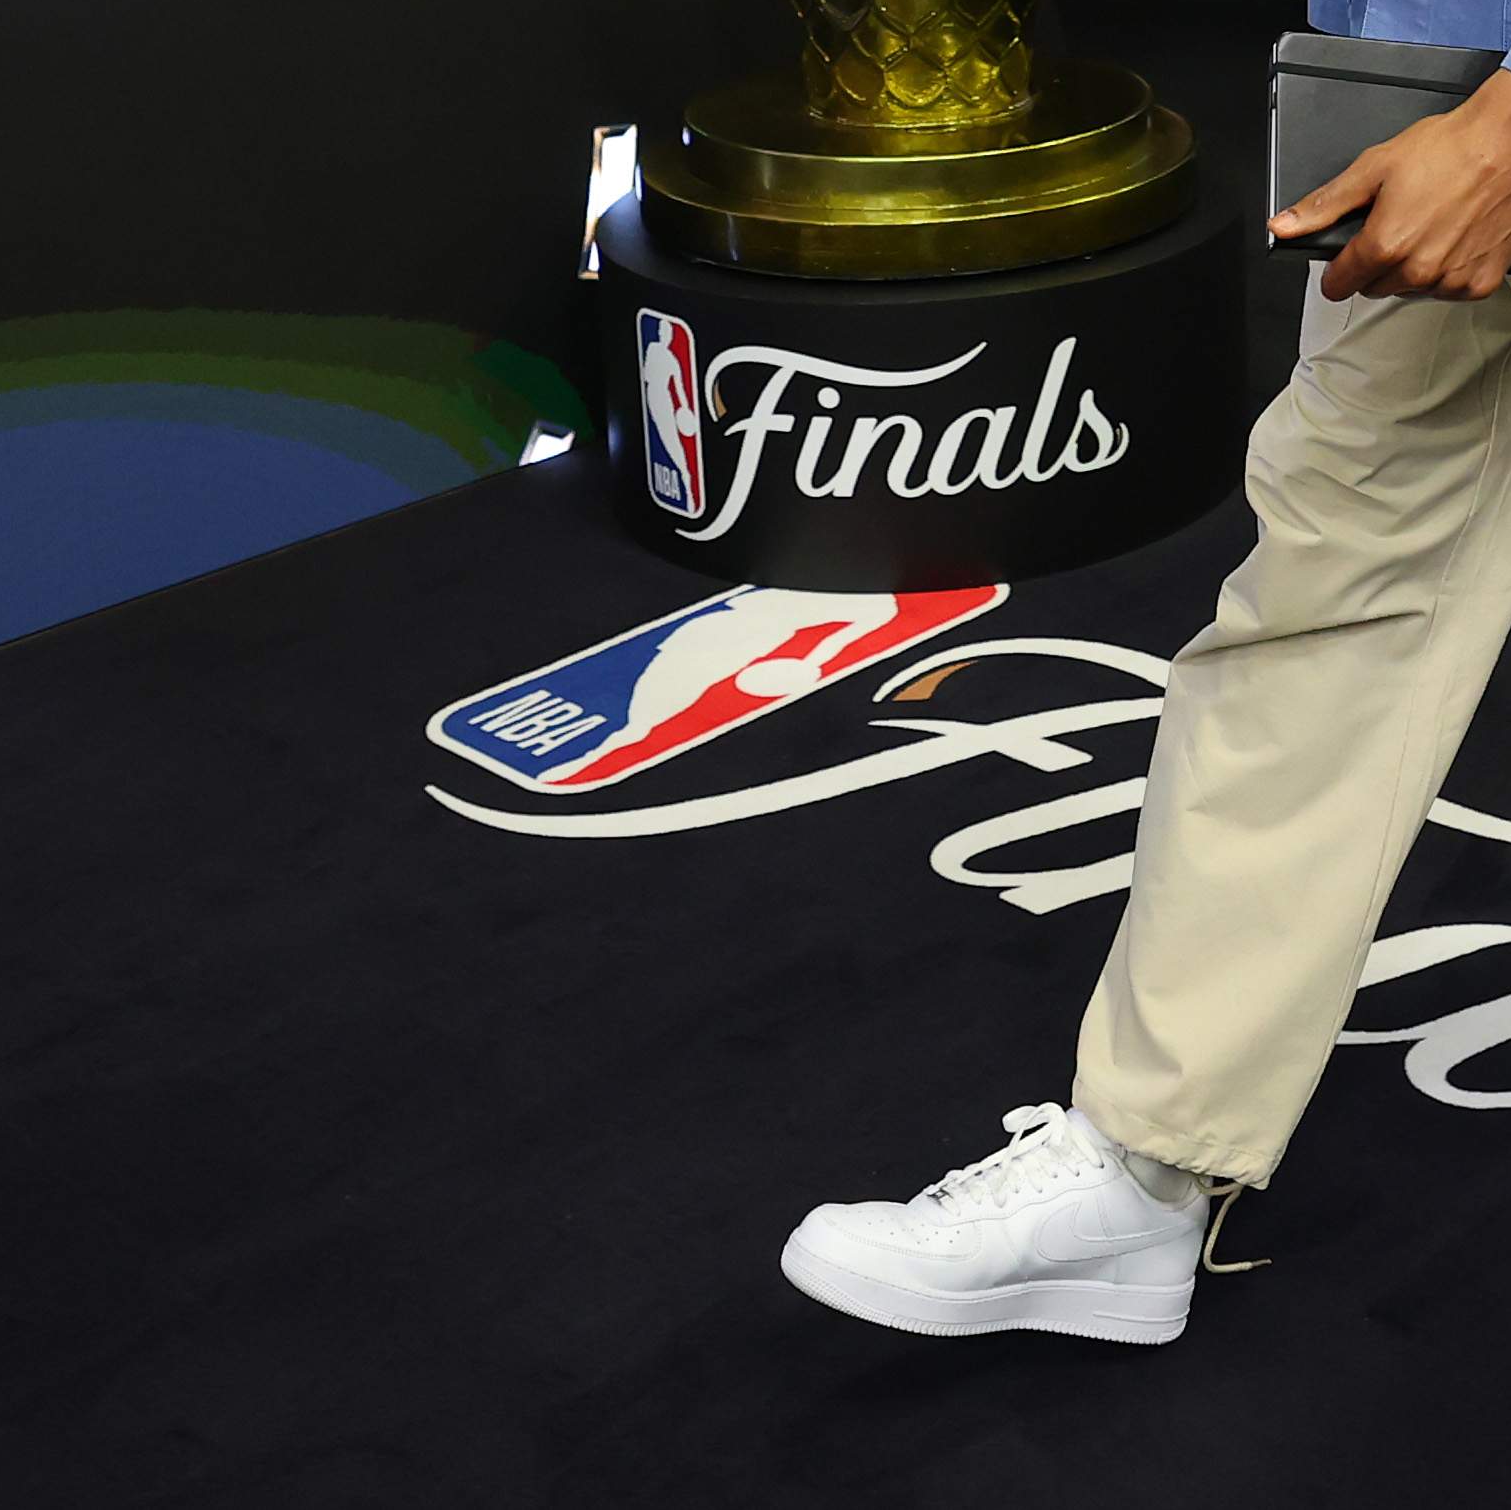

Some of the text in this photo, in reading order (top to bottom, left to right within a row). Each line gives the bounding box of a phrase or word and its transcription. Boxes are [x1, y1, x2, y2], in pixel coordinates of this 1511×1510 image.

[653, 336, 1130, 541] NBA Finals
[467, 689, 608, 757] NBA
